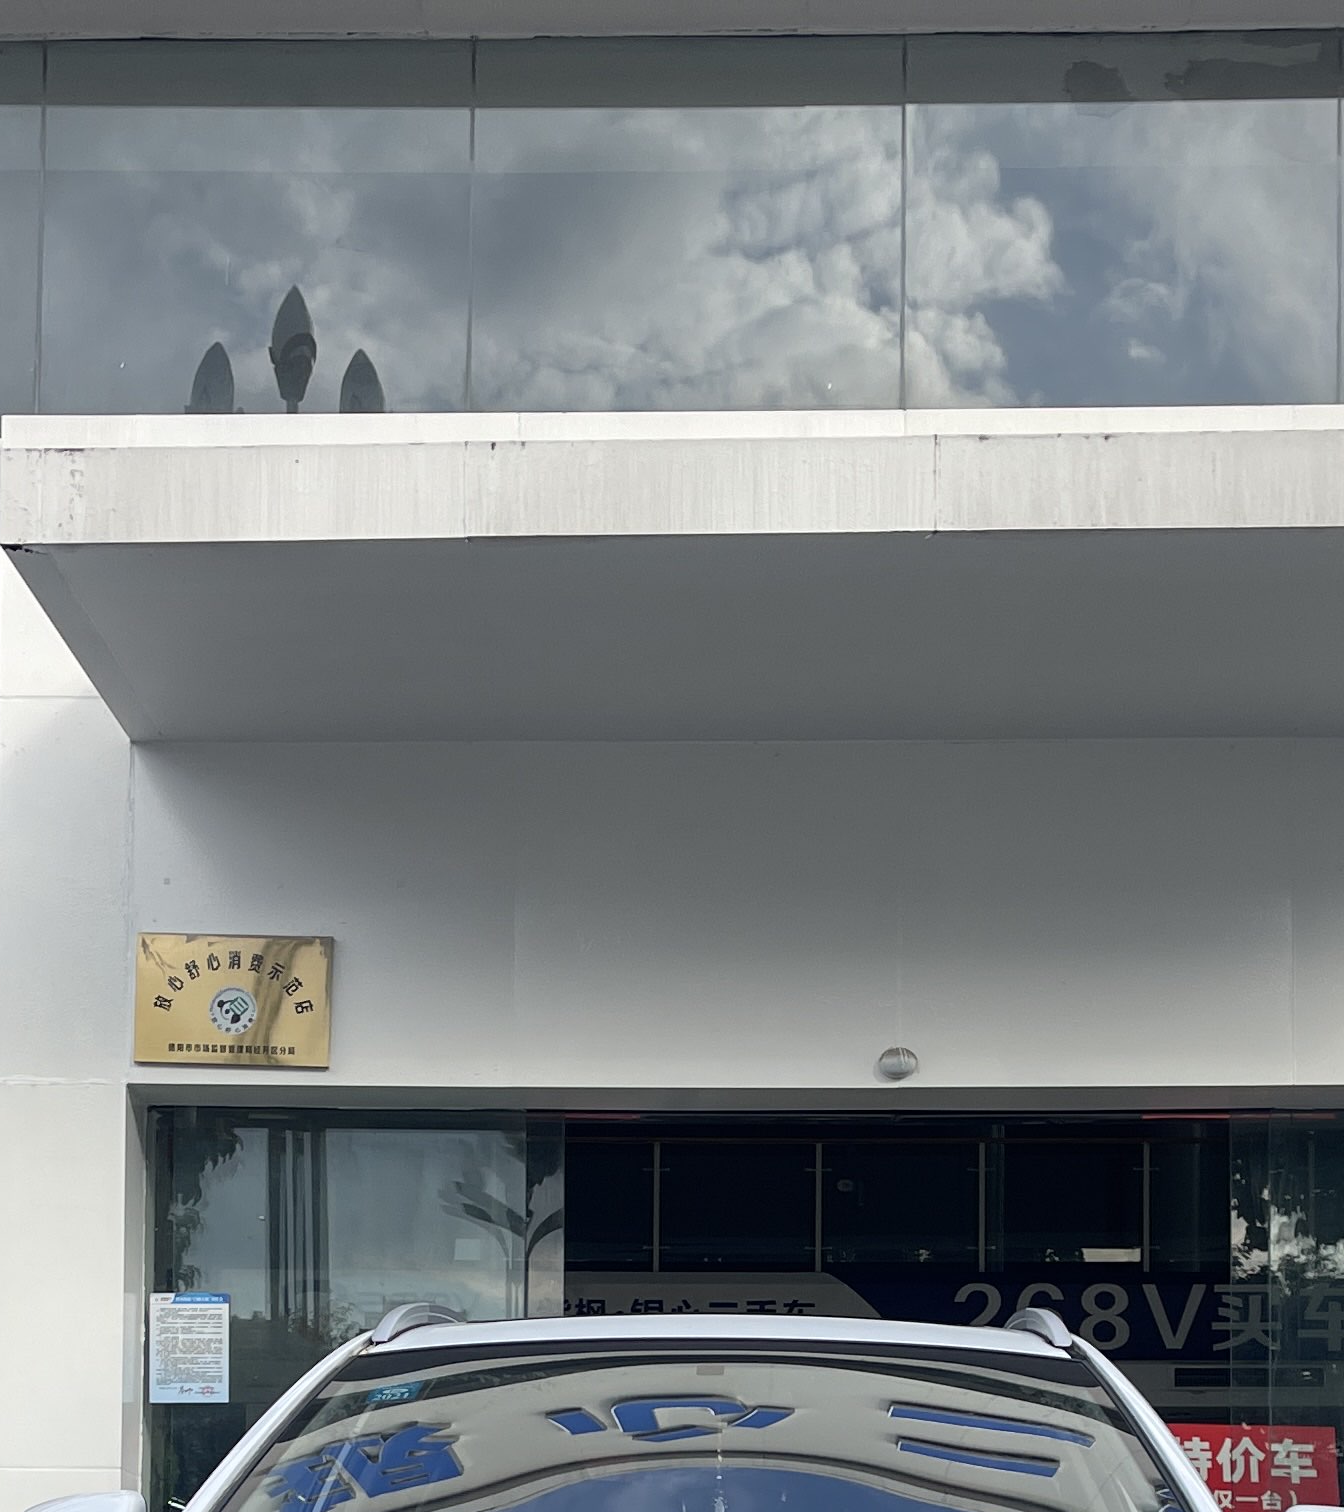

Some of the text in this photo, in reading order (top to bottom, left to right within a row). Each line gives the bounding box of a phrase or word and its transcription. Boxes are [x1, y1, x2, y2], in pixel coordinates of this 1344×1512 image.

[153, 950, 314, 1015] 放心舒心消费示范店
